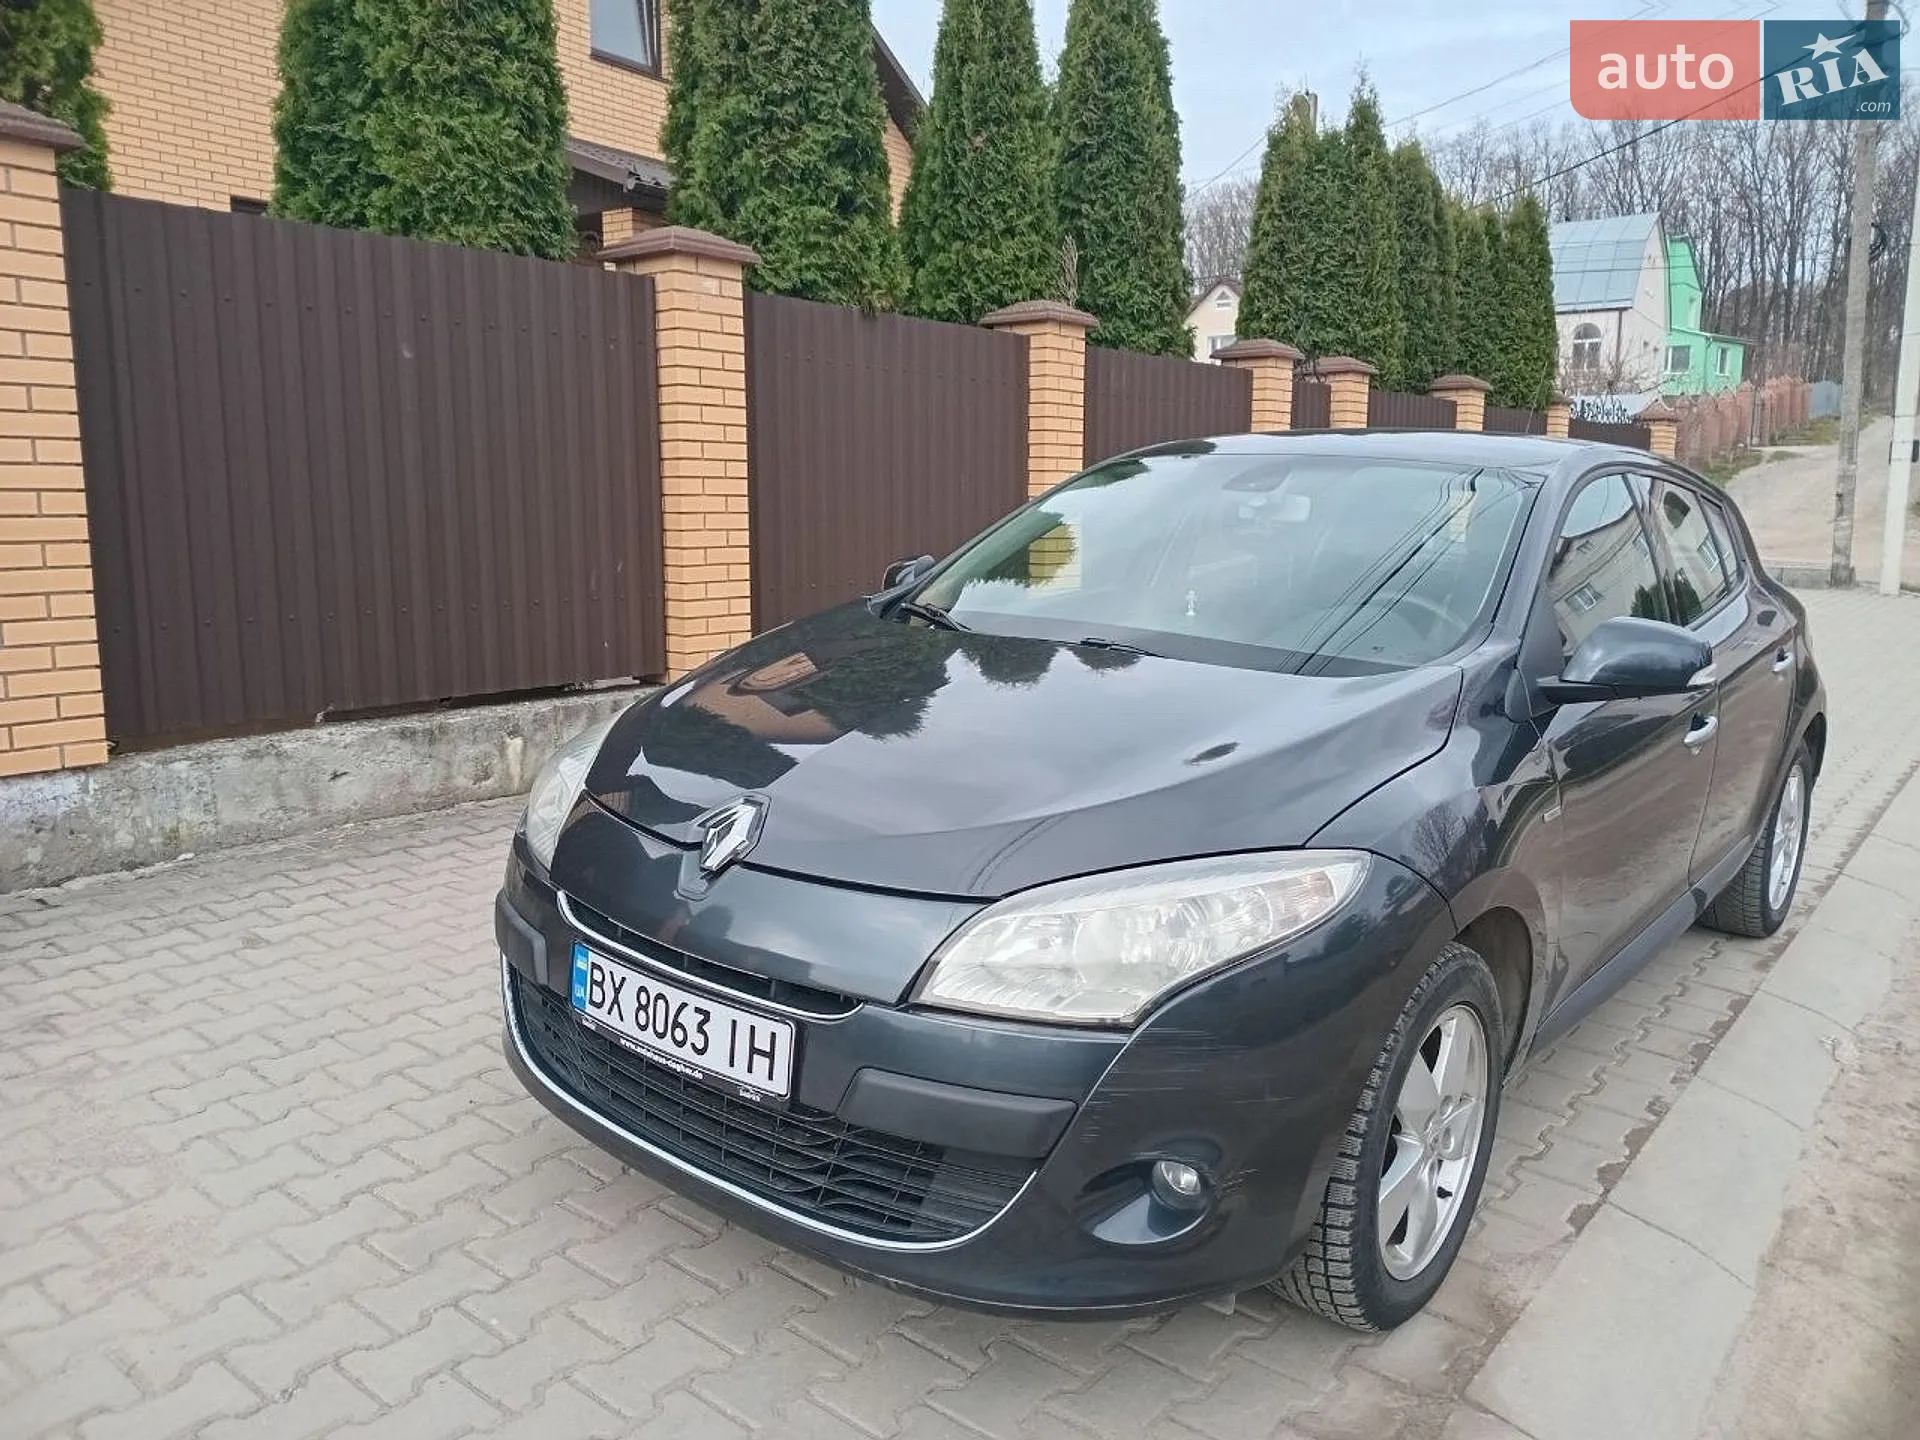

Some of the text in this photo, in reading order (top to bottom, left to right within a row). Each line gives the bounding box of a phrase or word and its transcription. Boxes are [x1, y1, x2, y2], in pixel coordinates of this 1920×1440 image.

[589, 961, 777, 1081] BX 8063 IH
